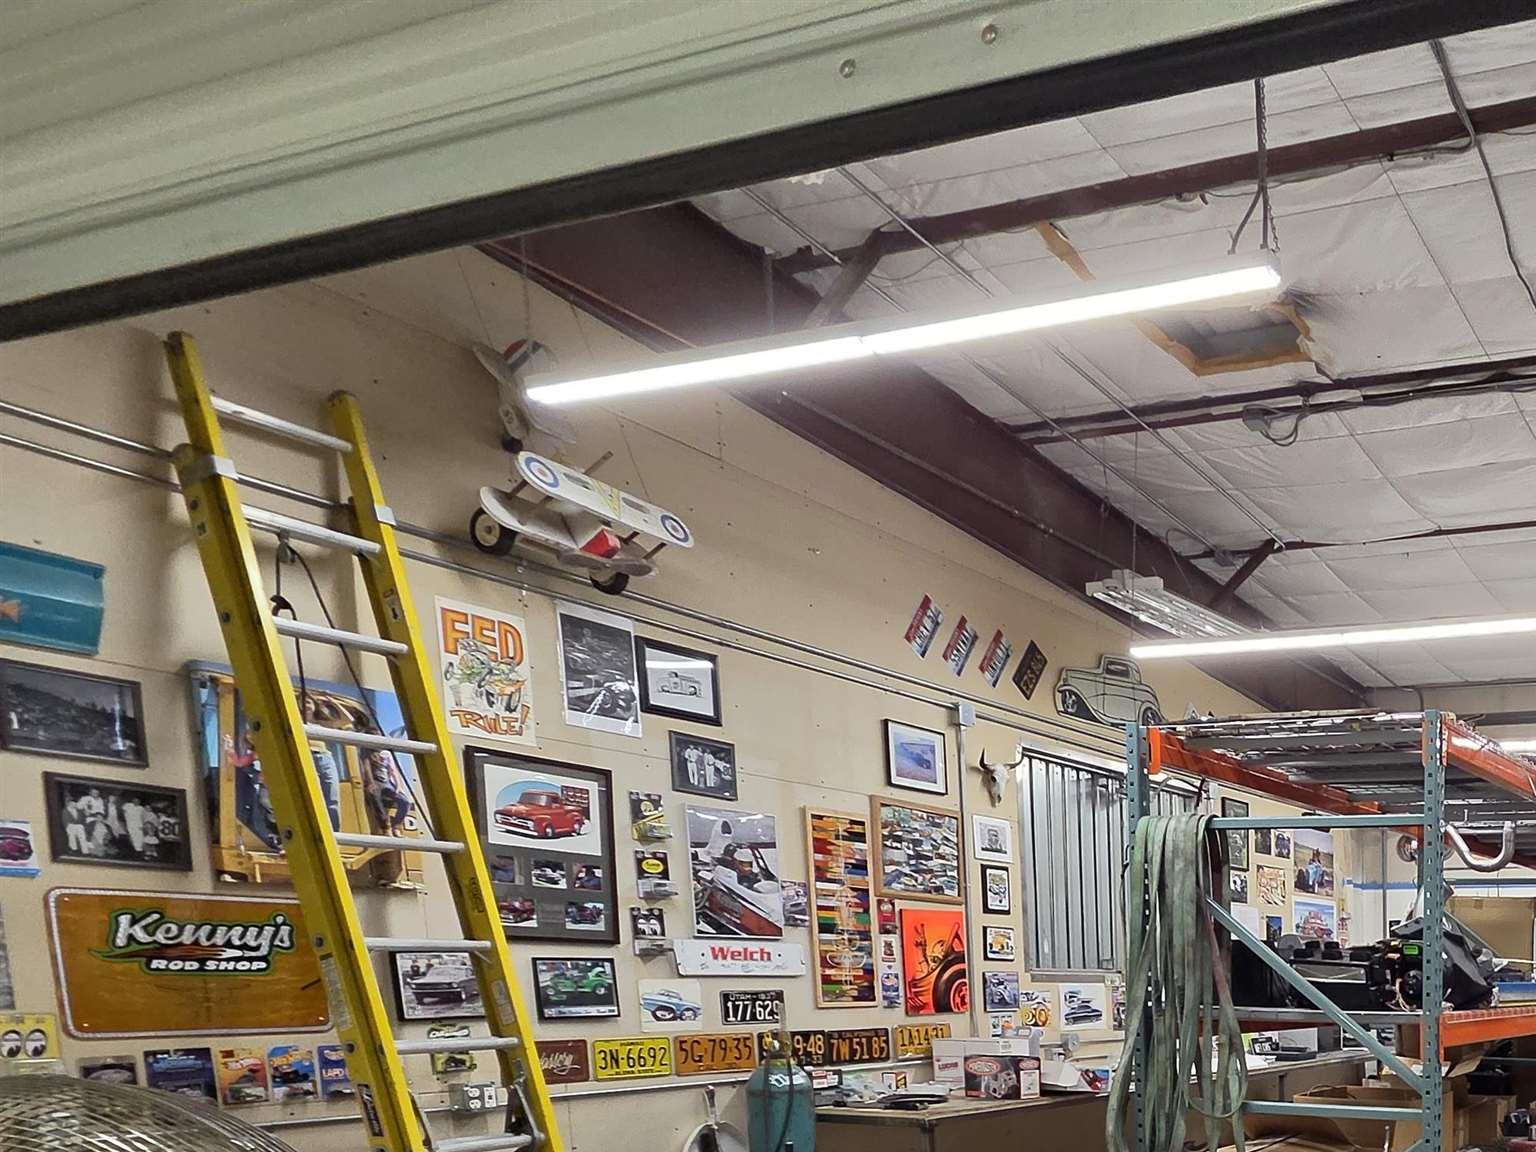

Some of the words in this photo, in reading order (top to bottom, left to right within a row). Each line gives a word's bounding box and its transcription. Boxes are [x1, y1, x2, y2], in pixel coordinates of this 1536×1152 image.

[441, 606, 525, 668] FED
[113, 911, 293, 956] Kenny's
[150, 958, 200, 971] ROD
[203, 958, 268, 971] SHOP
[710, 945, 773, 963] Welch
[598, 1046, 668, 1071] 3N-6692
